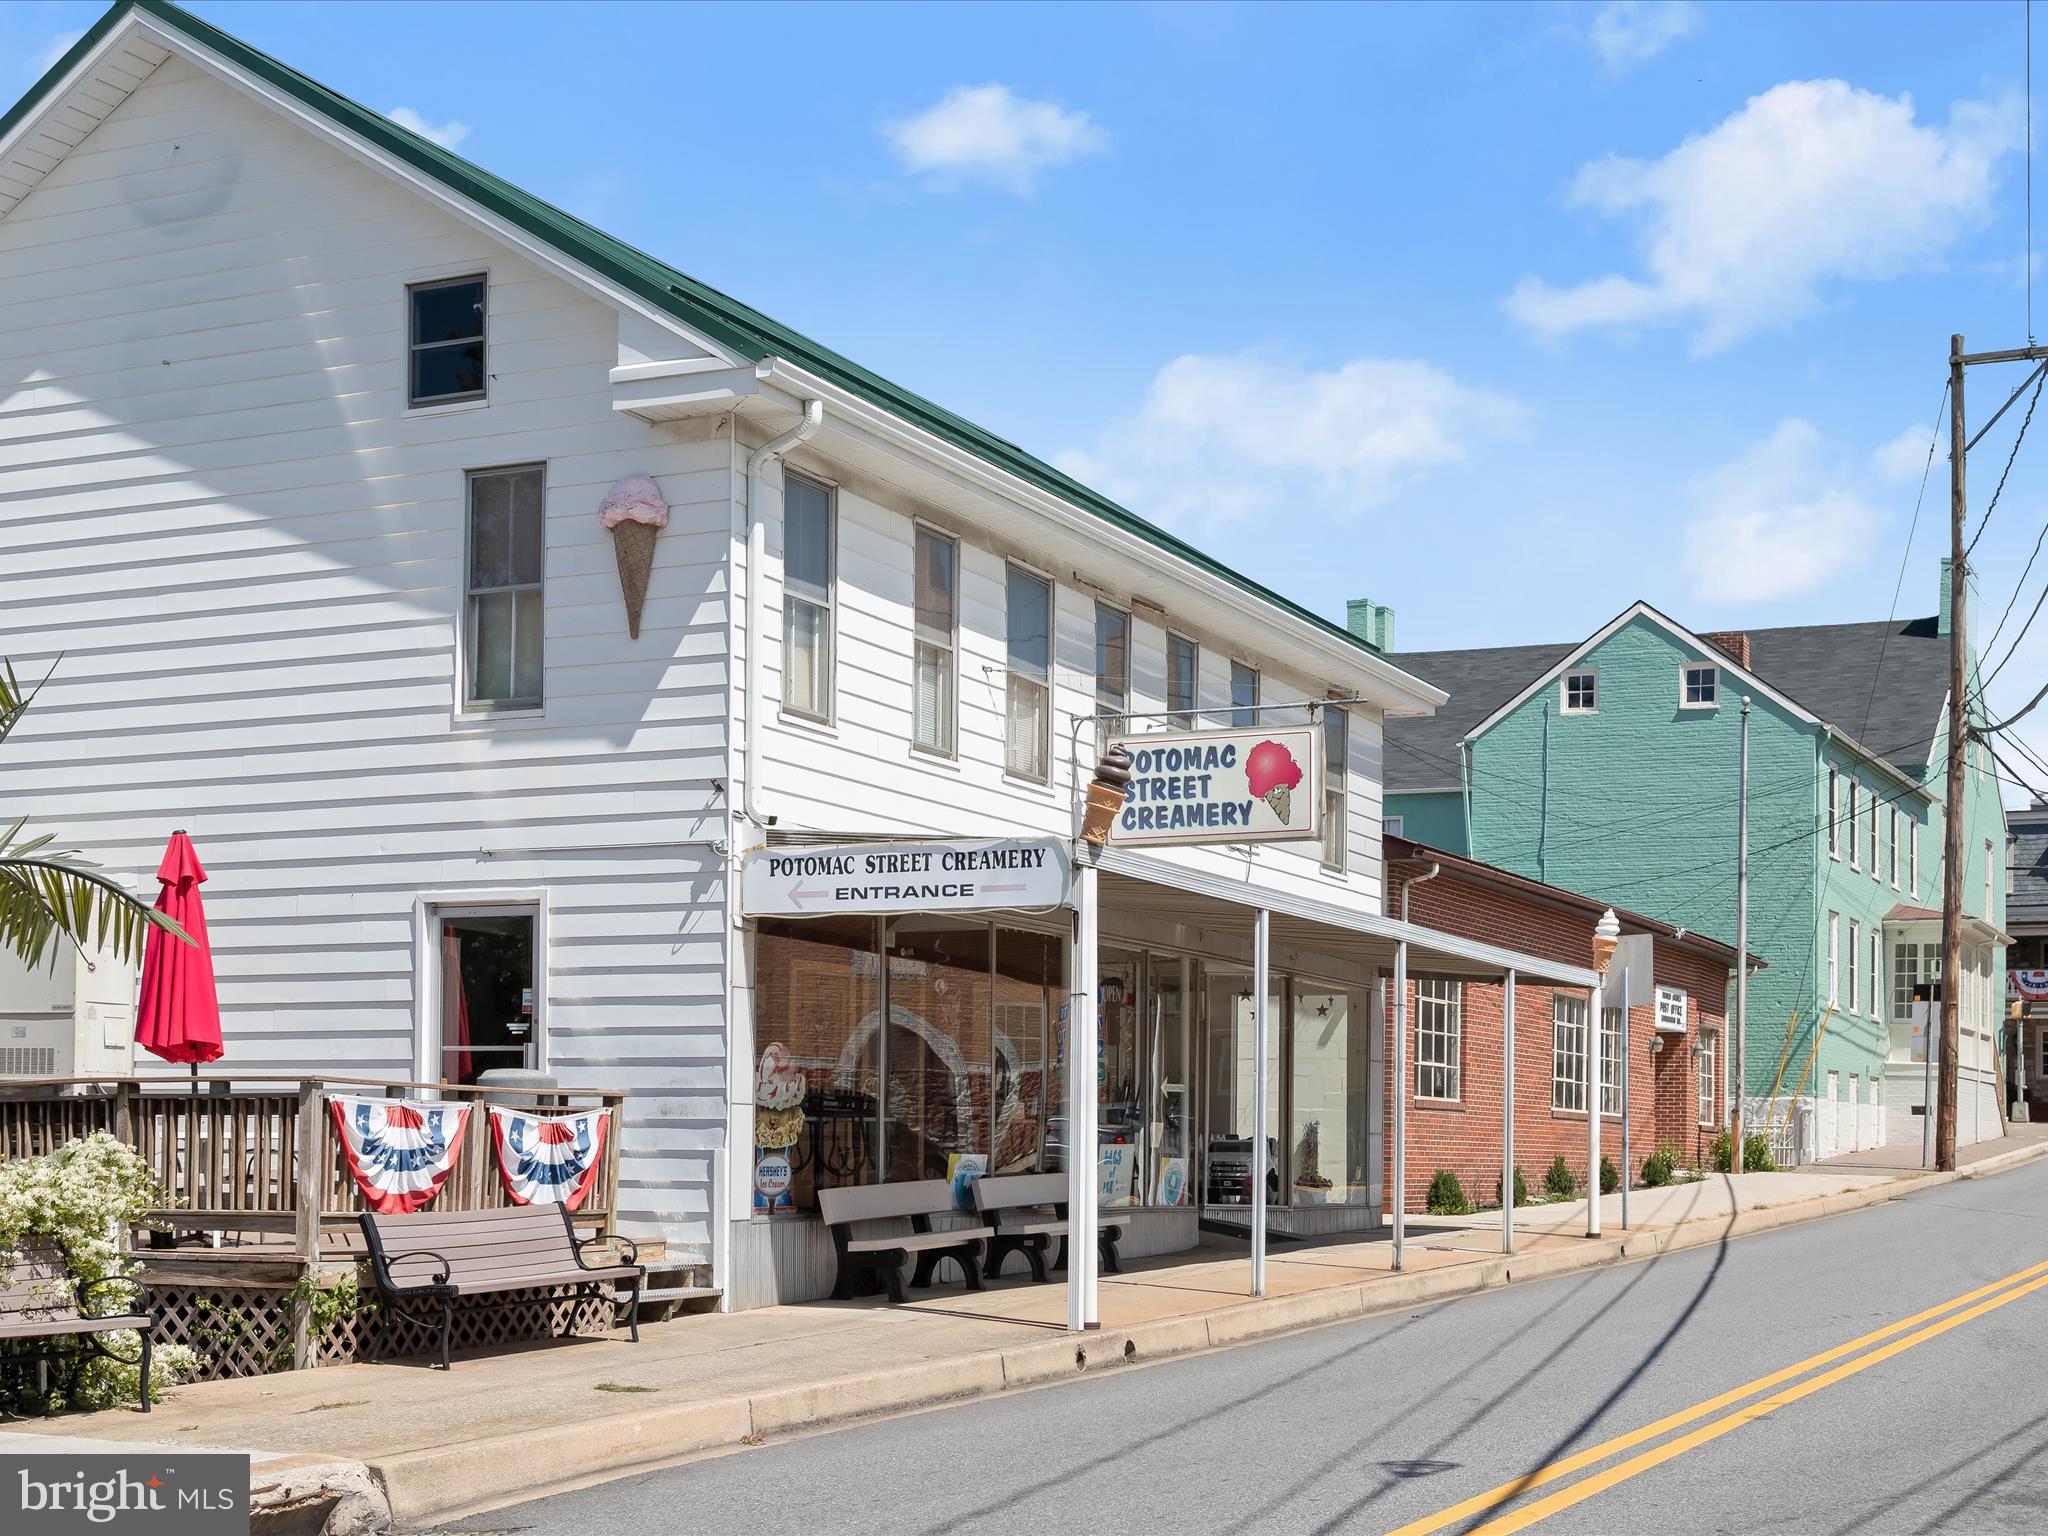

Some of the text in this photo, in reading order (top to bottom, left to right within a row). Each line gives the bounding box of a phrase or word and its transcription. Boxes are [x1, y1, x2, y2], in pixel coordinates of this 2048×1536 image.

[1124, 774, 1212, 803] STREET
[1121, 800, 1253, 831] CREAMERY
[769, 848, 1047, 877] POTOMAC STREET CREAMERY
[835, 883, 975, 901] ENTRANCE
[1104, 985, 1122, 1002] OPEN
[758, 1165, 788, 1177] HERSHEY'S
[760, 1178, 785, 1188] Ice Cream
